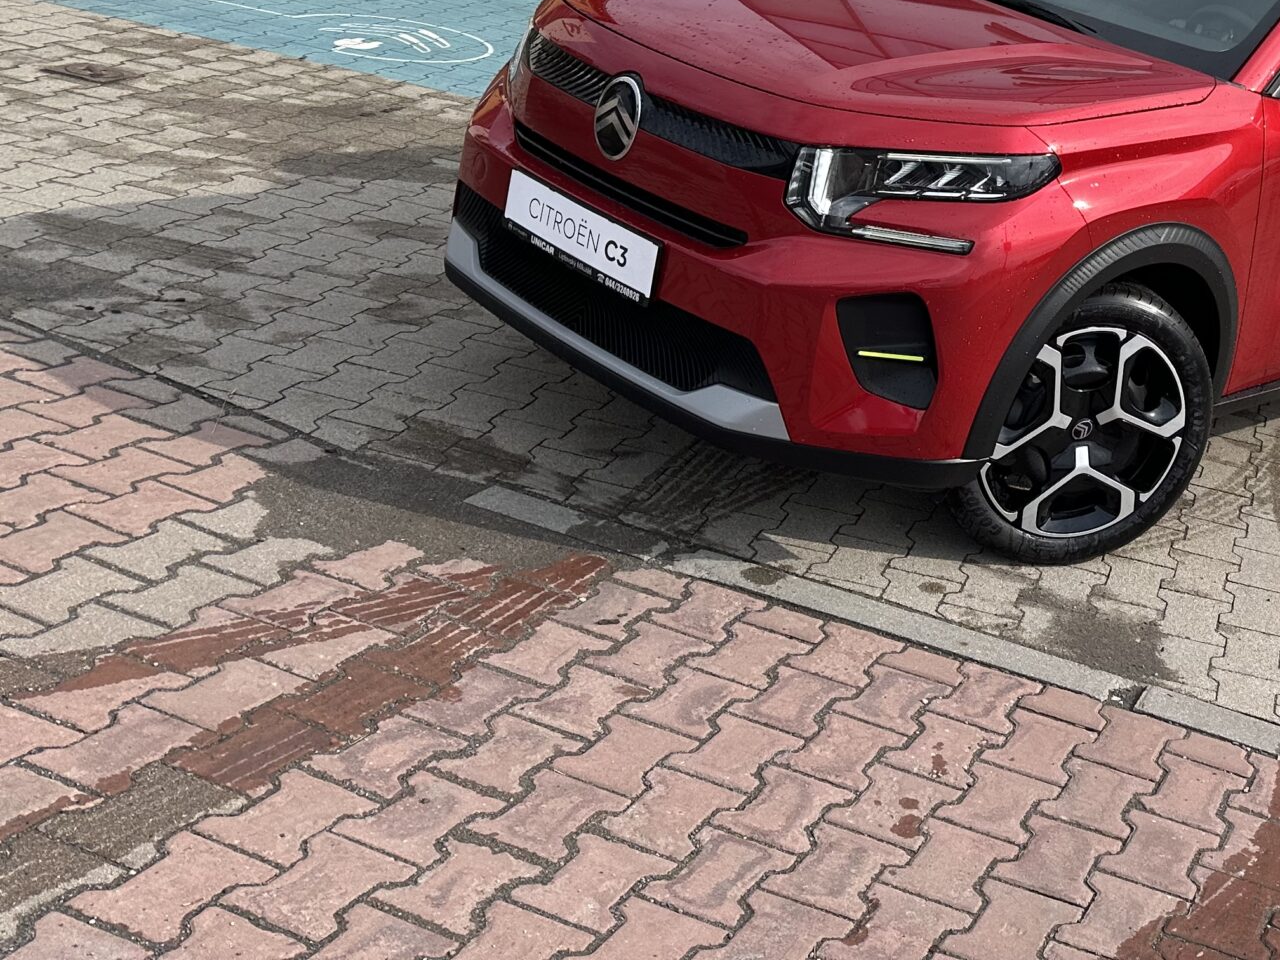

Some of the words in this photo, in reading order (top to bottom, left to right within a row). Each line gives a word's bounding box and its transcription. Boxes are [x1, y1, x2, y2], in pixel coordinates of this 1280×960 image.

[528, 197, 601, 254] CITROËN
[604, 239, 629, 268] C3
[530, 235, 555, 256] UNICAR
